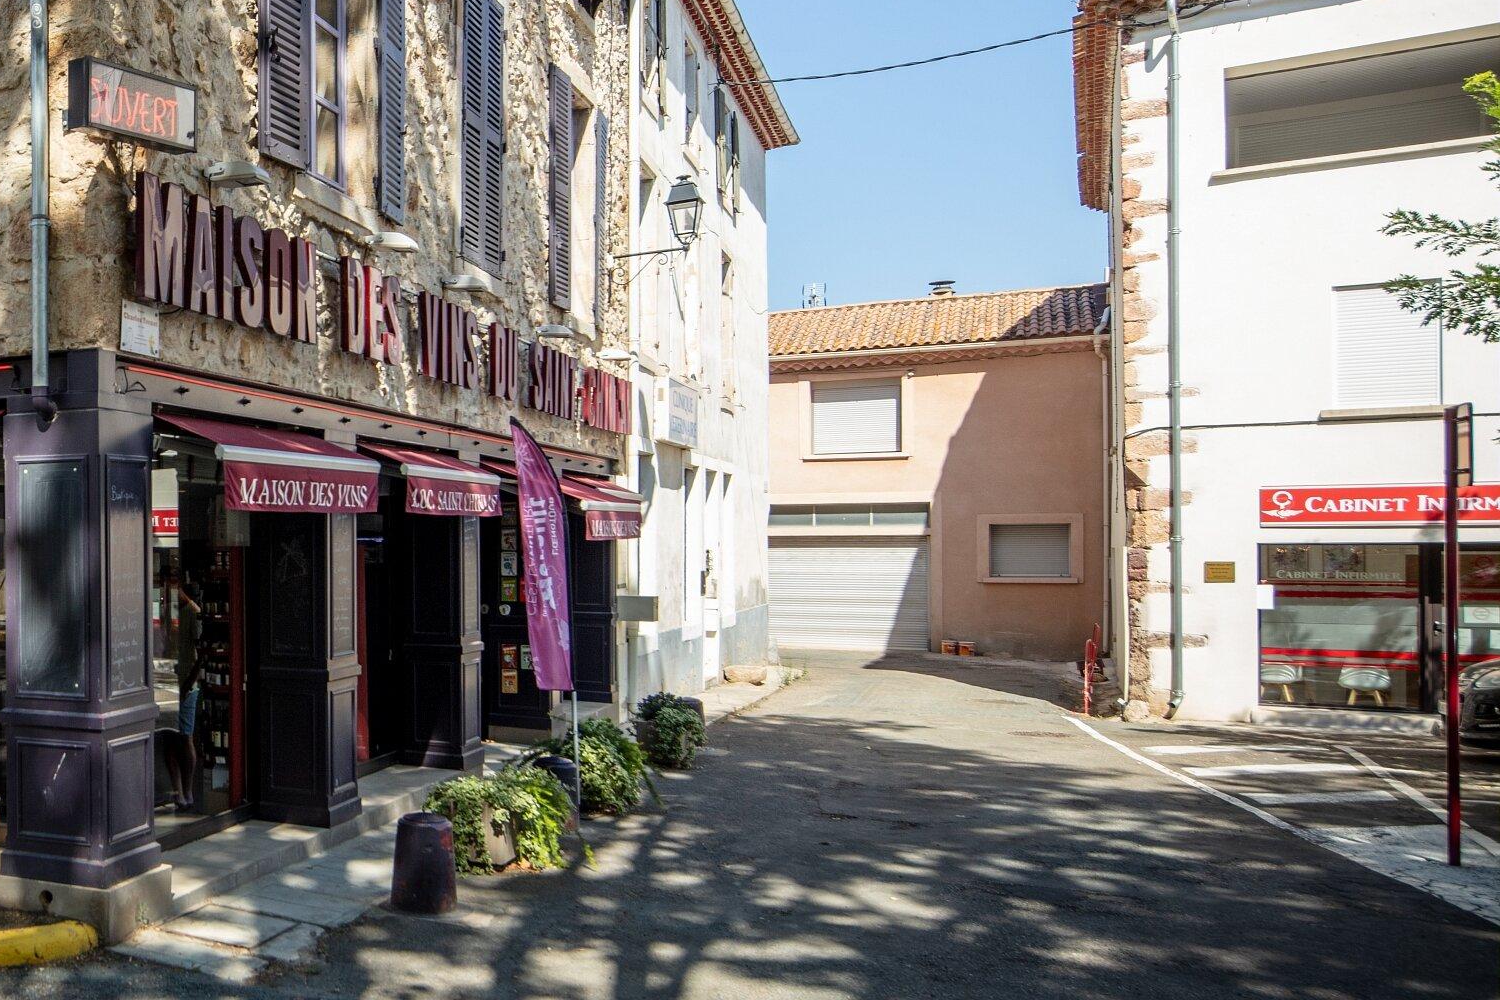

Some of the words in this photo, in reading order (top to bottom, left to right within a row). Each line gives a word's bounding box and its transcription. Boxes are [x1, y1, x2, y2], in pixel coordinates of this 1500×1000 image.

[135, 170, 317, 345] MAISON
[340, 255, 401, 366] DES
[418, 291, 479, 391] VINS
[489, 321, 519, 402] DU
[240, 477, 306, 506] MAISON
[308, 481, 334, 507] DES
[337, 483, 368, 508] VINS
[437, 490, 463, 511] SAINT
[1304, 496, 1410, 513] CABINET
[1416, 494, 1500, 512] INIRM
[1276, 569, 1329, 580] CABINET
[1335, 569, 1402, 580] INFIRMIER
